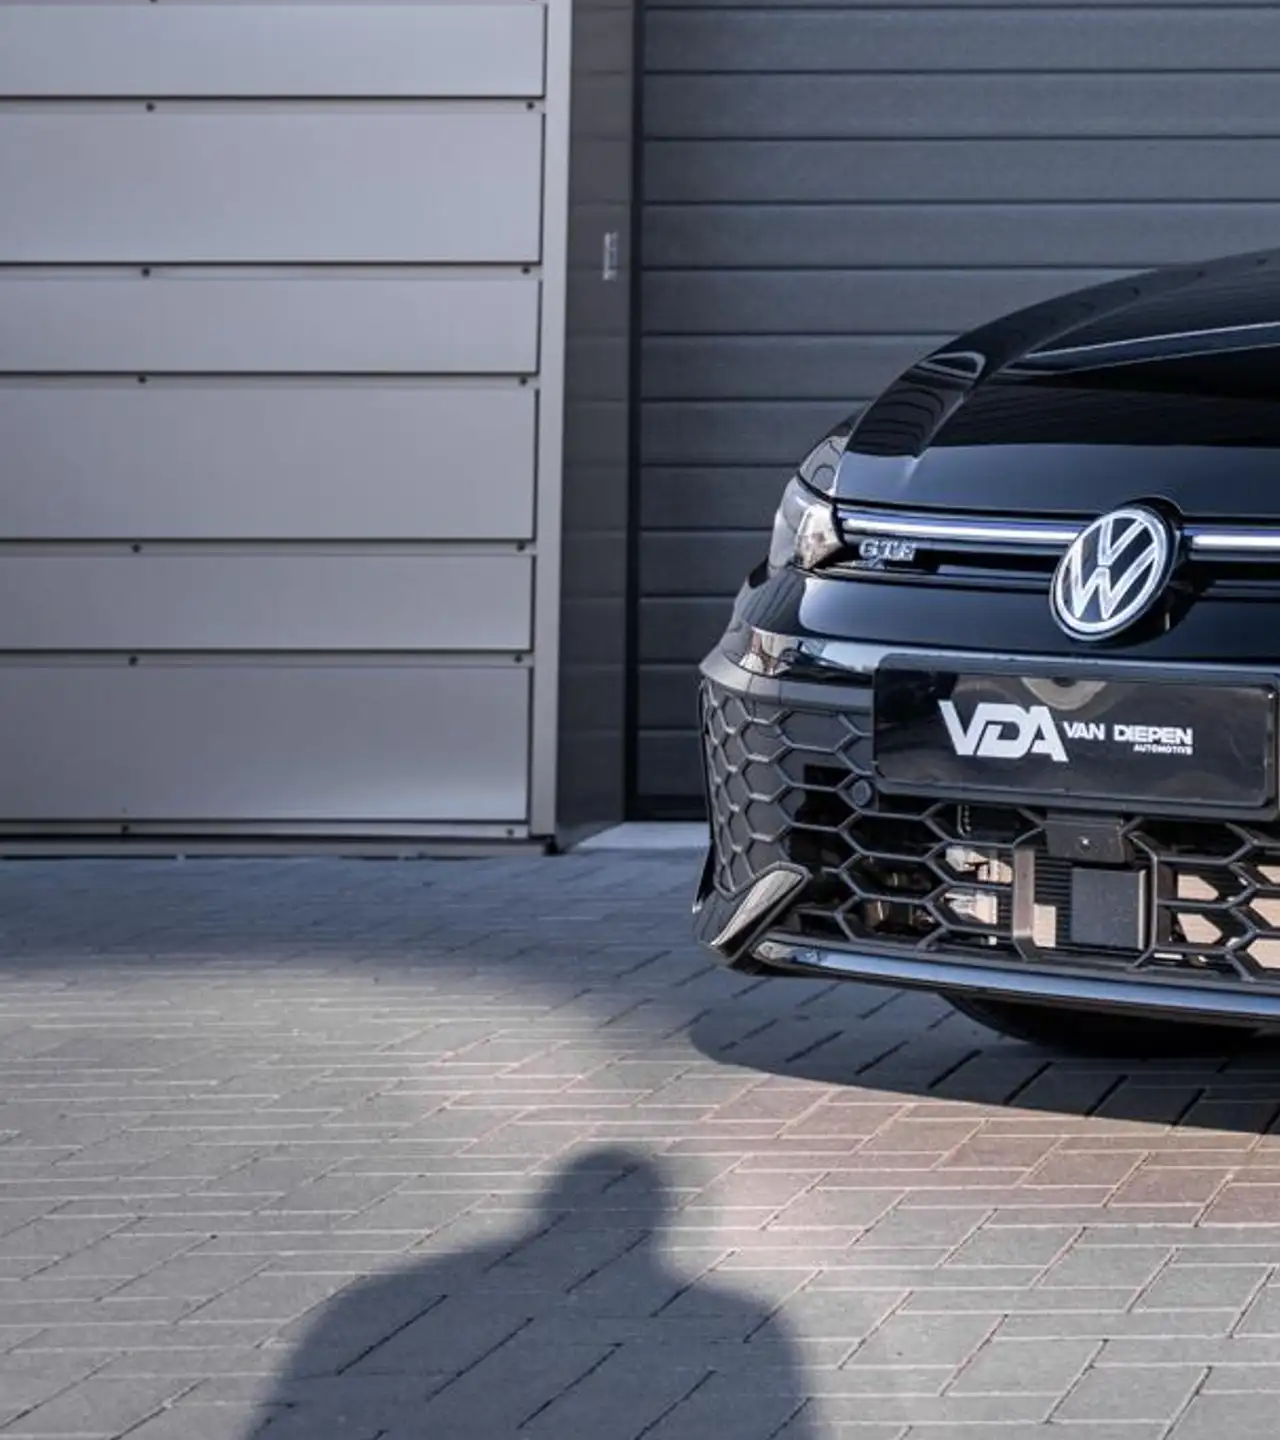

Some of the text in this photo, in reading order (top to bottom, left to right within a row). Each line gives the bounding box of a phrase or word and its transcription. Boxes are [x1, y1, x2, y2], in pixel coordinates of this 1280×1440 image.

[937, 699, 1069, 762] VDA
[1063, 720, 1194, 745] VAN DIEPEN
